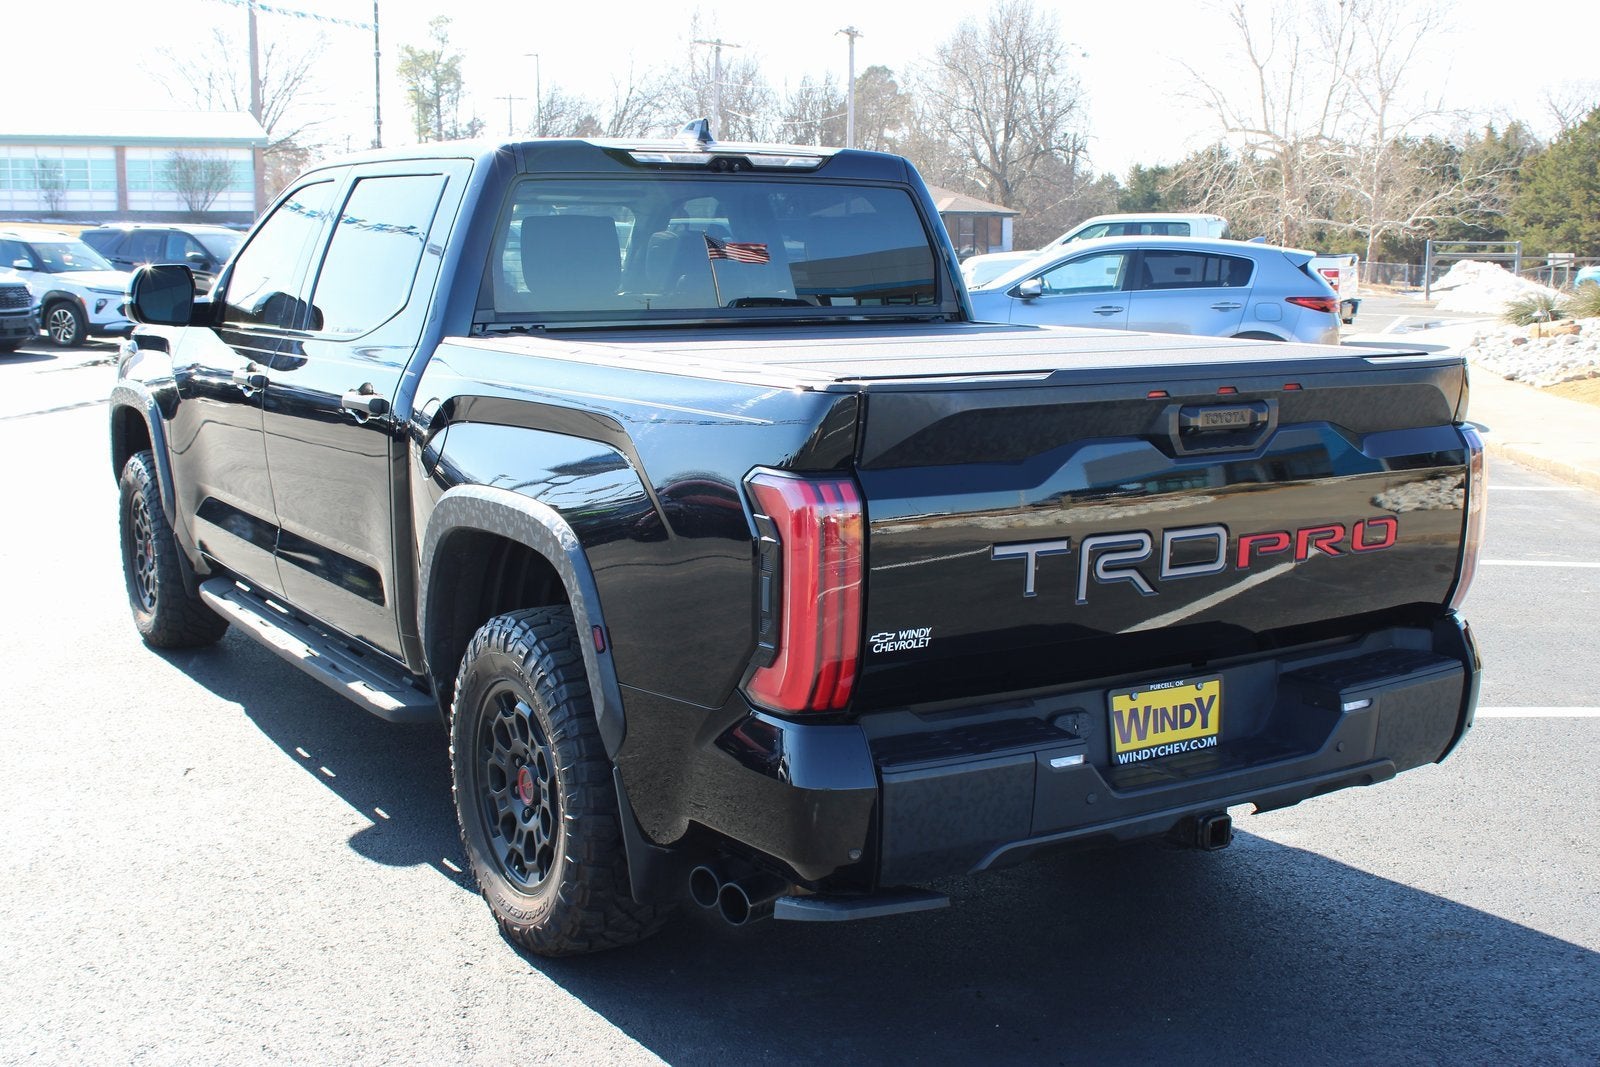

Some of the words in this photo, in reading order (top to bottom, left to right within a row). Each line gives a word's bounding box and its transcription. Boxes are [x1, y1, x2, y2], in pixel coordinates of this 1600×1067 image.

[1204, 411, 1246, 425] TOYOTA
[991, 523, 1230, 605] TRD
[1236, 515, 1398, 571] PRO
[898, 627, 932, 640] WINDY
[872, 637, 931, 653] CHEVROLET
[1118, 736, 1217, 764] WINDYCHEV.COM
